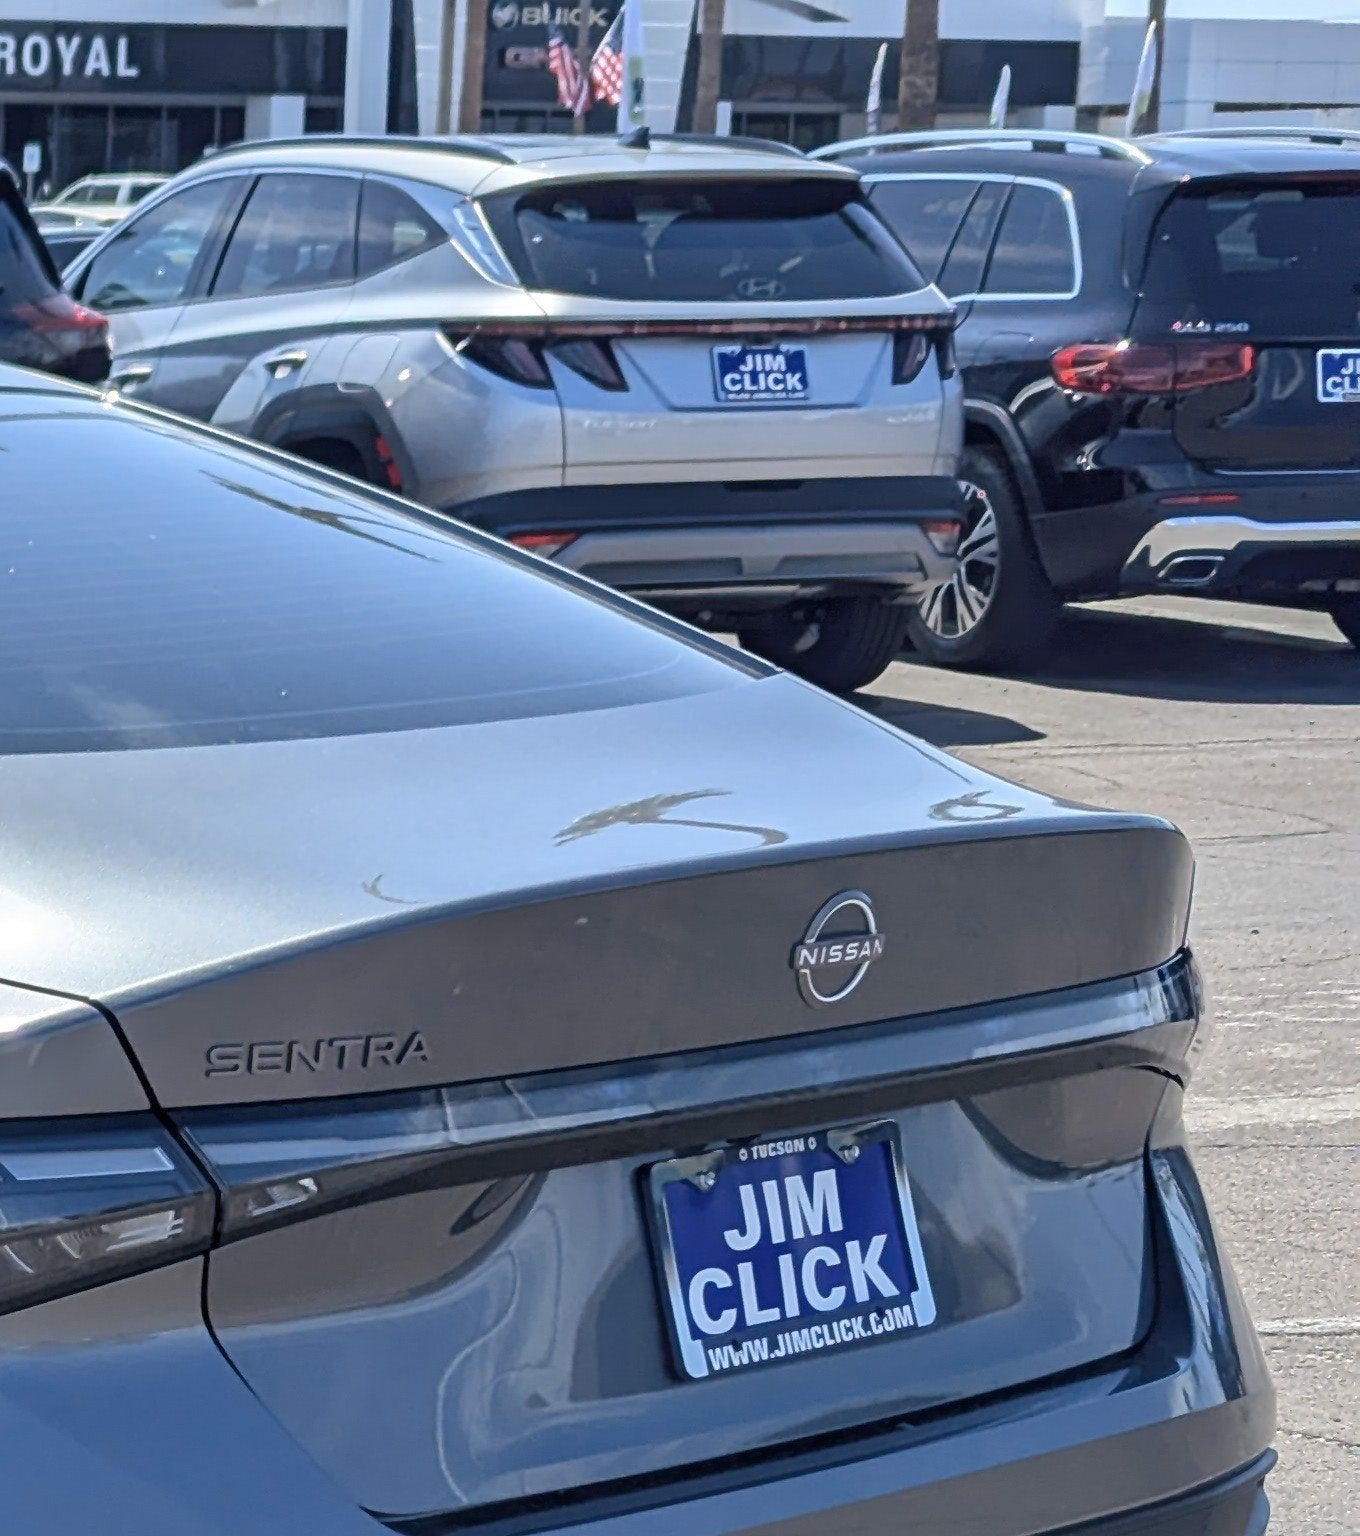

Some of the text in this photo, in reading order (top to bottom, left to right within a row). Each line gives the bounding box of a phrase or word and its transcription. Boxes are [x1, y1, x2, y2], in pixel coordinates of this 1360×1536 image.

[723, 372, 804, 391] CLICK
[739, 354, 787, 372] JIM
[798, 938, 883, 966] NISSAN
[205, 1030, 430, 1078] SENTRA
[751, 1138, 805, 1160] TUCSON
[724, 1168, 844, 1251] JIM
[688, 1234, 901, 1336] CLICK
[708, 1305, 914, 1371] WWW.JIMCLICK.COM
